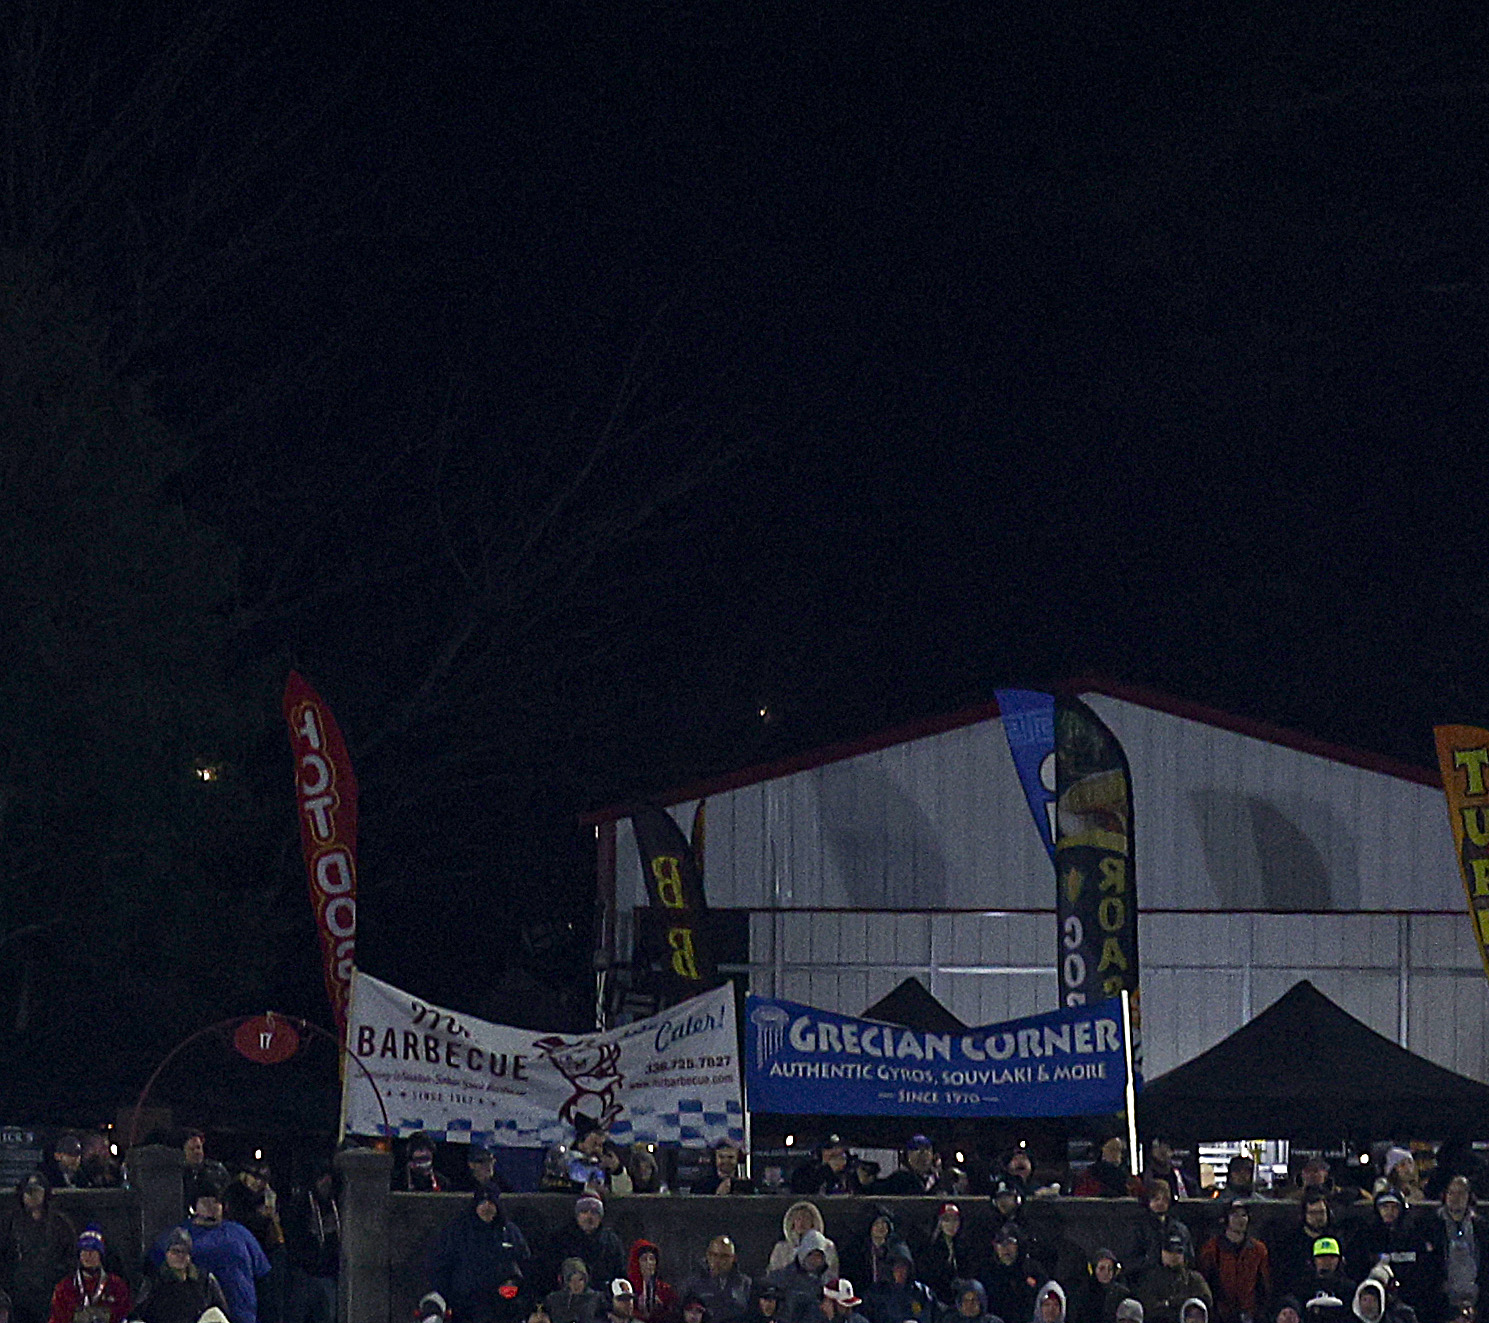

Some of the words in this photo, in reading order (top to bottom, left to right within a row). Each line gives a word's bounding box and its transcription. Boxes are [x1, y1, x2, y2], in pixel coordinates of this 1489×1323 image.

[356, 1025, 529, 1081] BARBECUE
[789, 1015, 952, 1062] GRECIAN
[960, 1018, 1120, 1061] CORNER
[769, 1061, 873, 1080] AUTHENTIC
[942, 1065, 1032, 1085] SOUVLAKI
[1053, 1062, 1107, 1081] MORE
